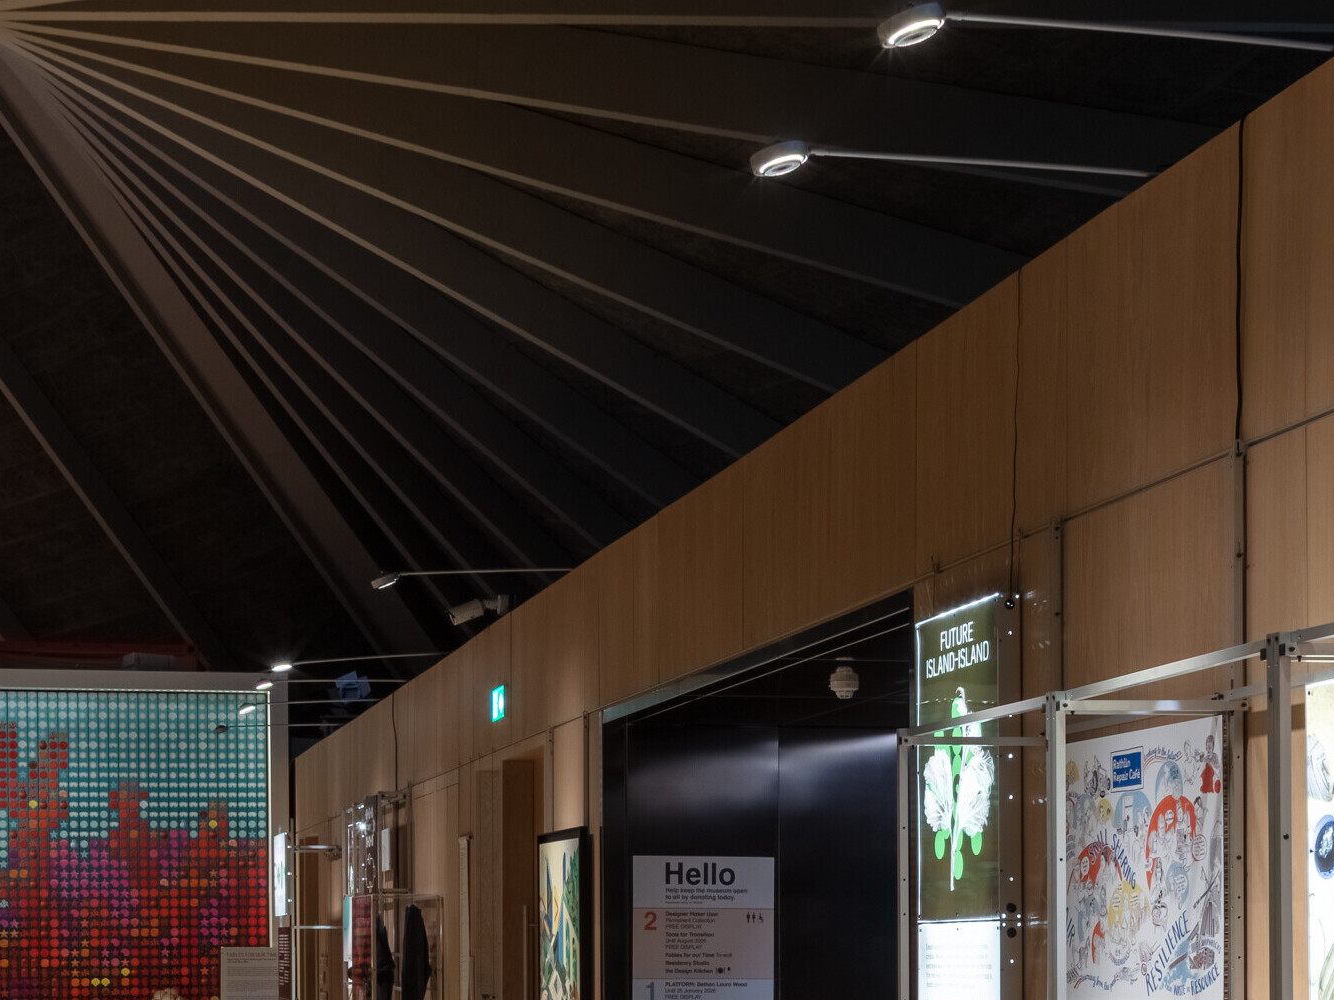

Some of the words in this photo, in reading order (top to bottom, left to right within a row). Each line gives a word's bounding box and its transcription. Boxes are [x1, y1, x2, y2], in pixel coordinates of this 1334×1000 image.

[940, 621, 974, 651] FUTURE
[926, 640, 990, 679] ISLAND-ISLAND
[1113, 771, 1128, 784] Repair
[665, 862, 735, 886] Hello
[643, 911, 657, 931] 2
[1145, 910, 1191, 997] RESILIENCE
[645, 982, 655, 1000] 1
[1190, 962, 1221, 996] RESOURCE
